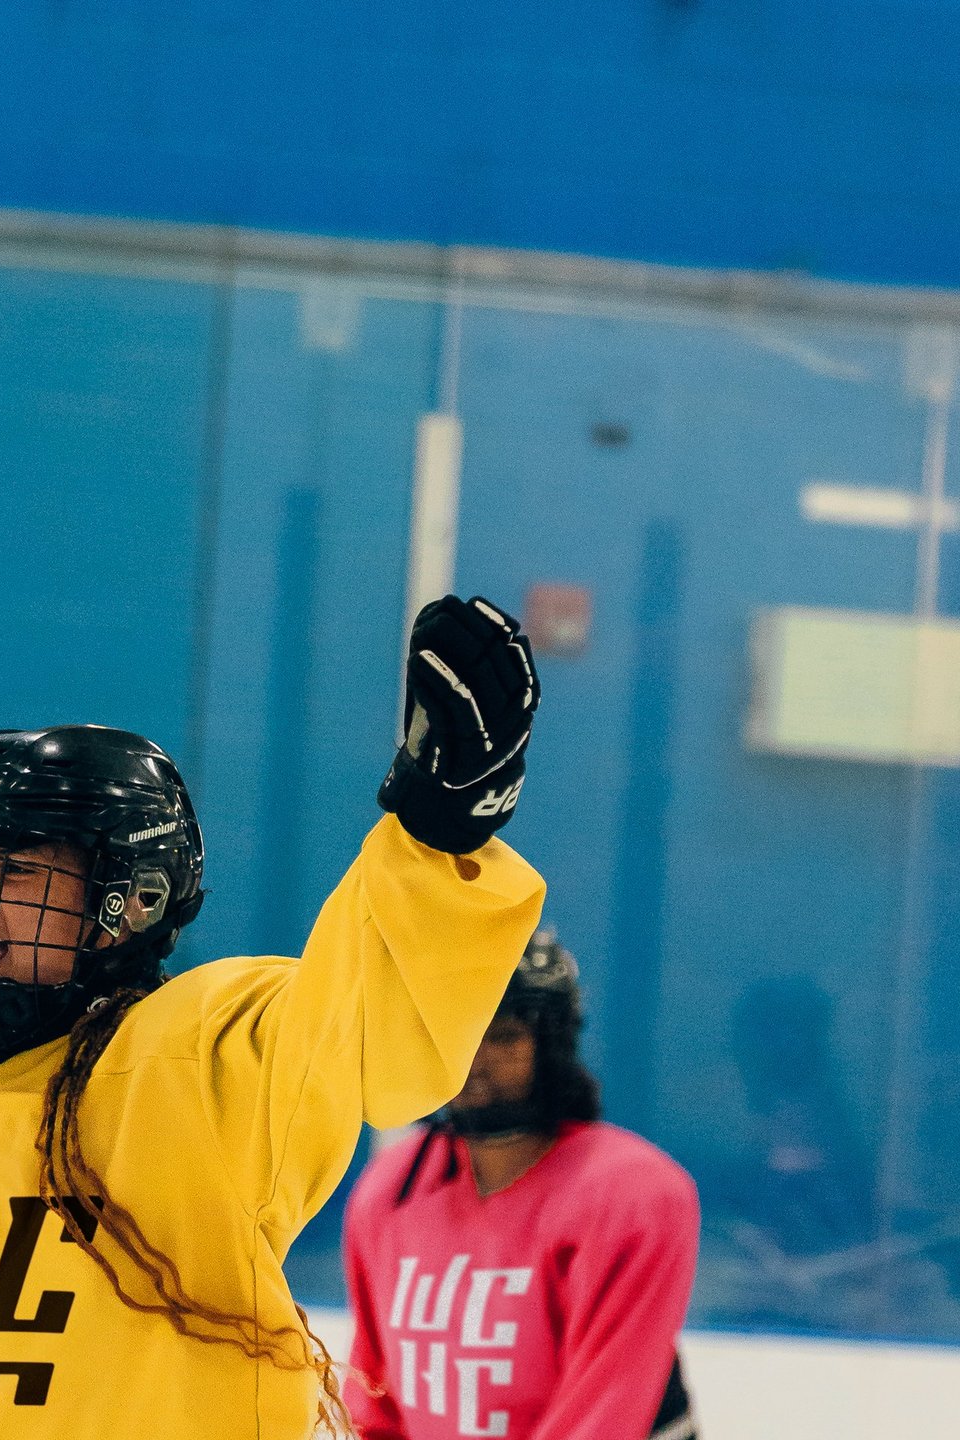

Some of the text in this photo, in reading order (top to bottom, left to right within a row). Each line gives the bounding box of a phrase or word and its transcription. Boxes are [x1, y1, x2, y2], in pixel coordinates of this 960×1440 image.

[128, 821, 178, 844] WARRIOR
[389, 1254, 533, 1348] WC
[399, 1340, 513, 1438] HC
